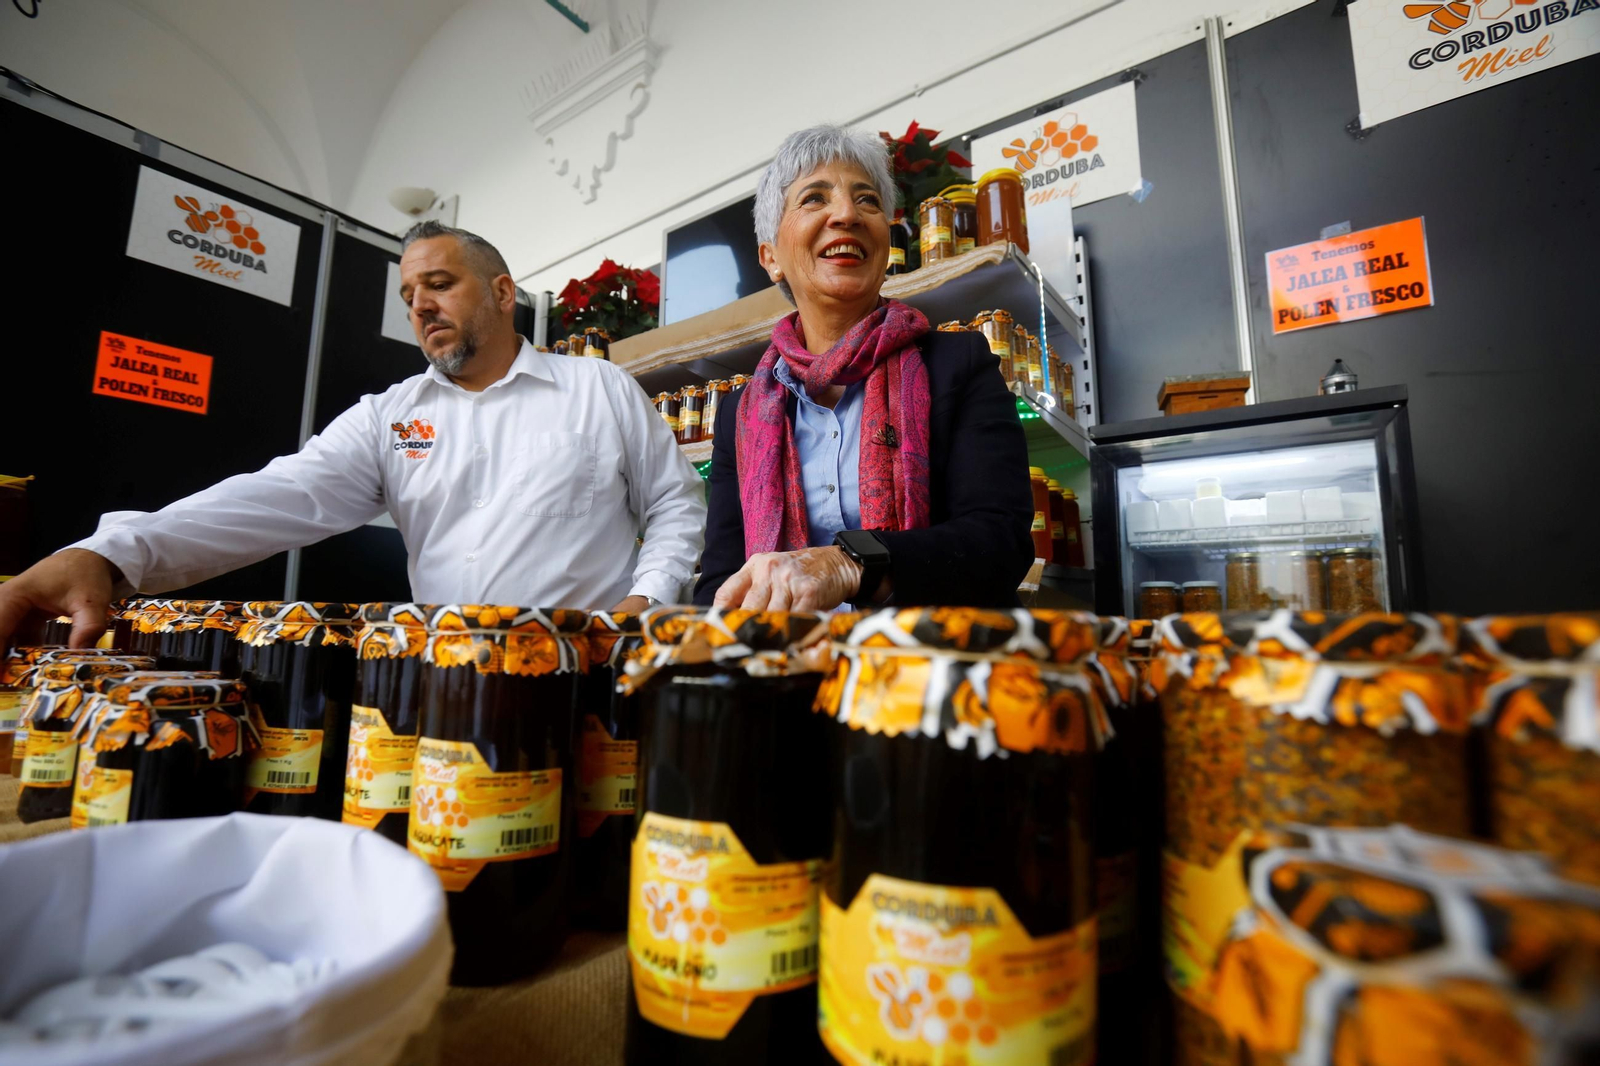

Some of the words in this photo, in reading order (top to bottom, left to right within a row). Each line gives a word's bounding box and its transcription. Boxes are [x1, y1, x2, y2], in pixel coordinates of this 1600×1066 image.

[1408, 0, 1600, 70] CORDUBA
[1457, 34, 1550, 82] Miel
[1024, 153, 1105, 191] ORDUBA
[1028, 181, 1079, 206] Miel
[167, 229, 268, 274] CORDUBA
[1311, 240, 1375, 262] Tenemos
[193, 255, 244, 281] Miel
[1286, 265, 1348, 292] JALEA
[1353, 252, 1409, 278] REAL
[1278, 297, 1340, 324] POLEN
[1346, 281, 1425, 310] FRESCO
[1342, 284, 1350, 293] &
[135, 345, 181, 363] Tenemos
[110, 356, 159, 376] JALEA
[163, 367, 199, 385] REAL
[98, 377, 149, 397] POLEN
[152, 387, 204, 407] FRESCO
[405, 450, 430, 459] Miel
[646, 825, 730, 854] CORDUBA
[872, 892, 999, 927] CORDUBA
